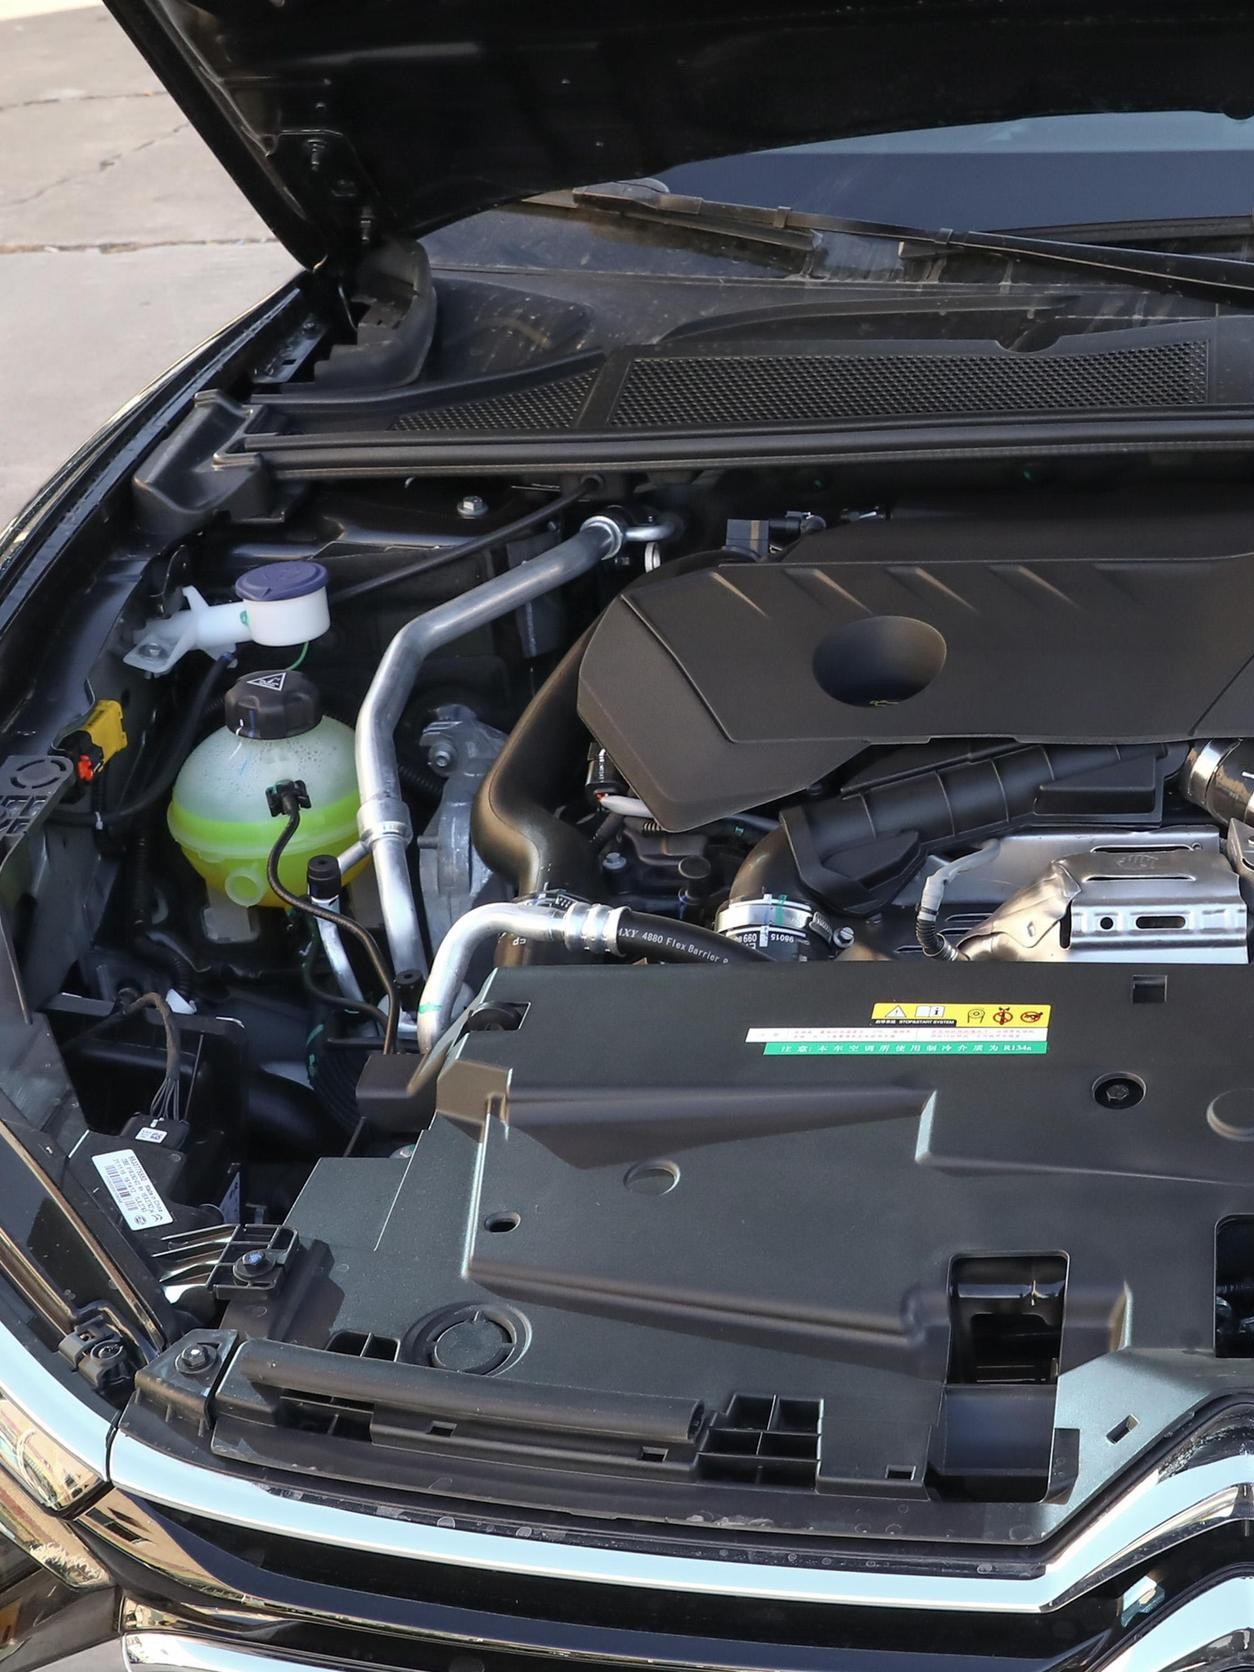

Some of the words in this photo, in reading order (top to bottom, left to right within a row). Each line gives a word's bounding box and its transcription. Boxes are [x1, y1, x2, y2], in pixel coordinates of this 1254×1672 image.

[642, 932, 663, 944] 4880
[666, 937, 688, 952] Flex
[688, 944, 720, 963] Barrier
